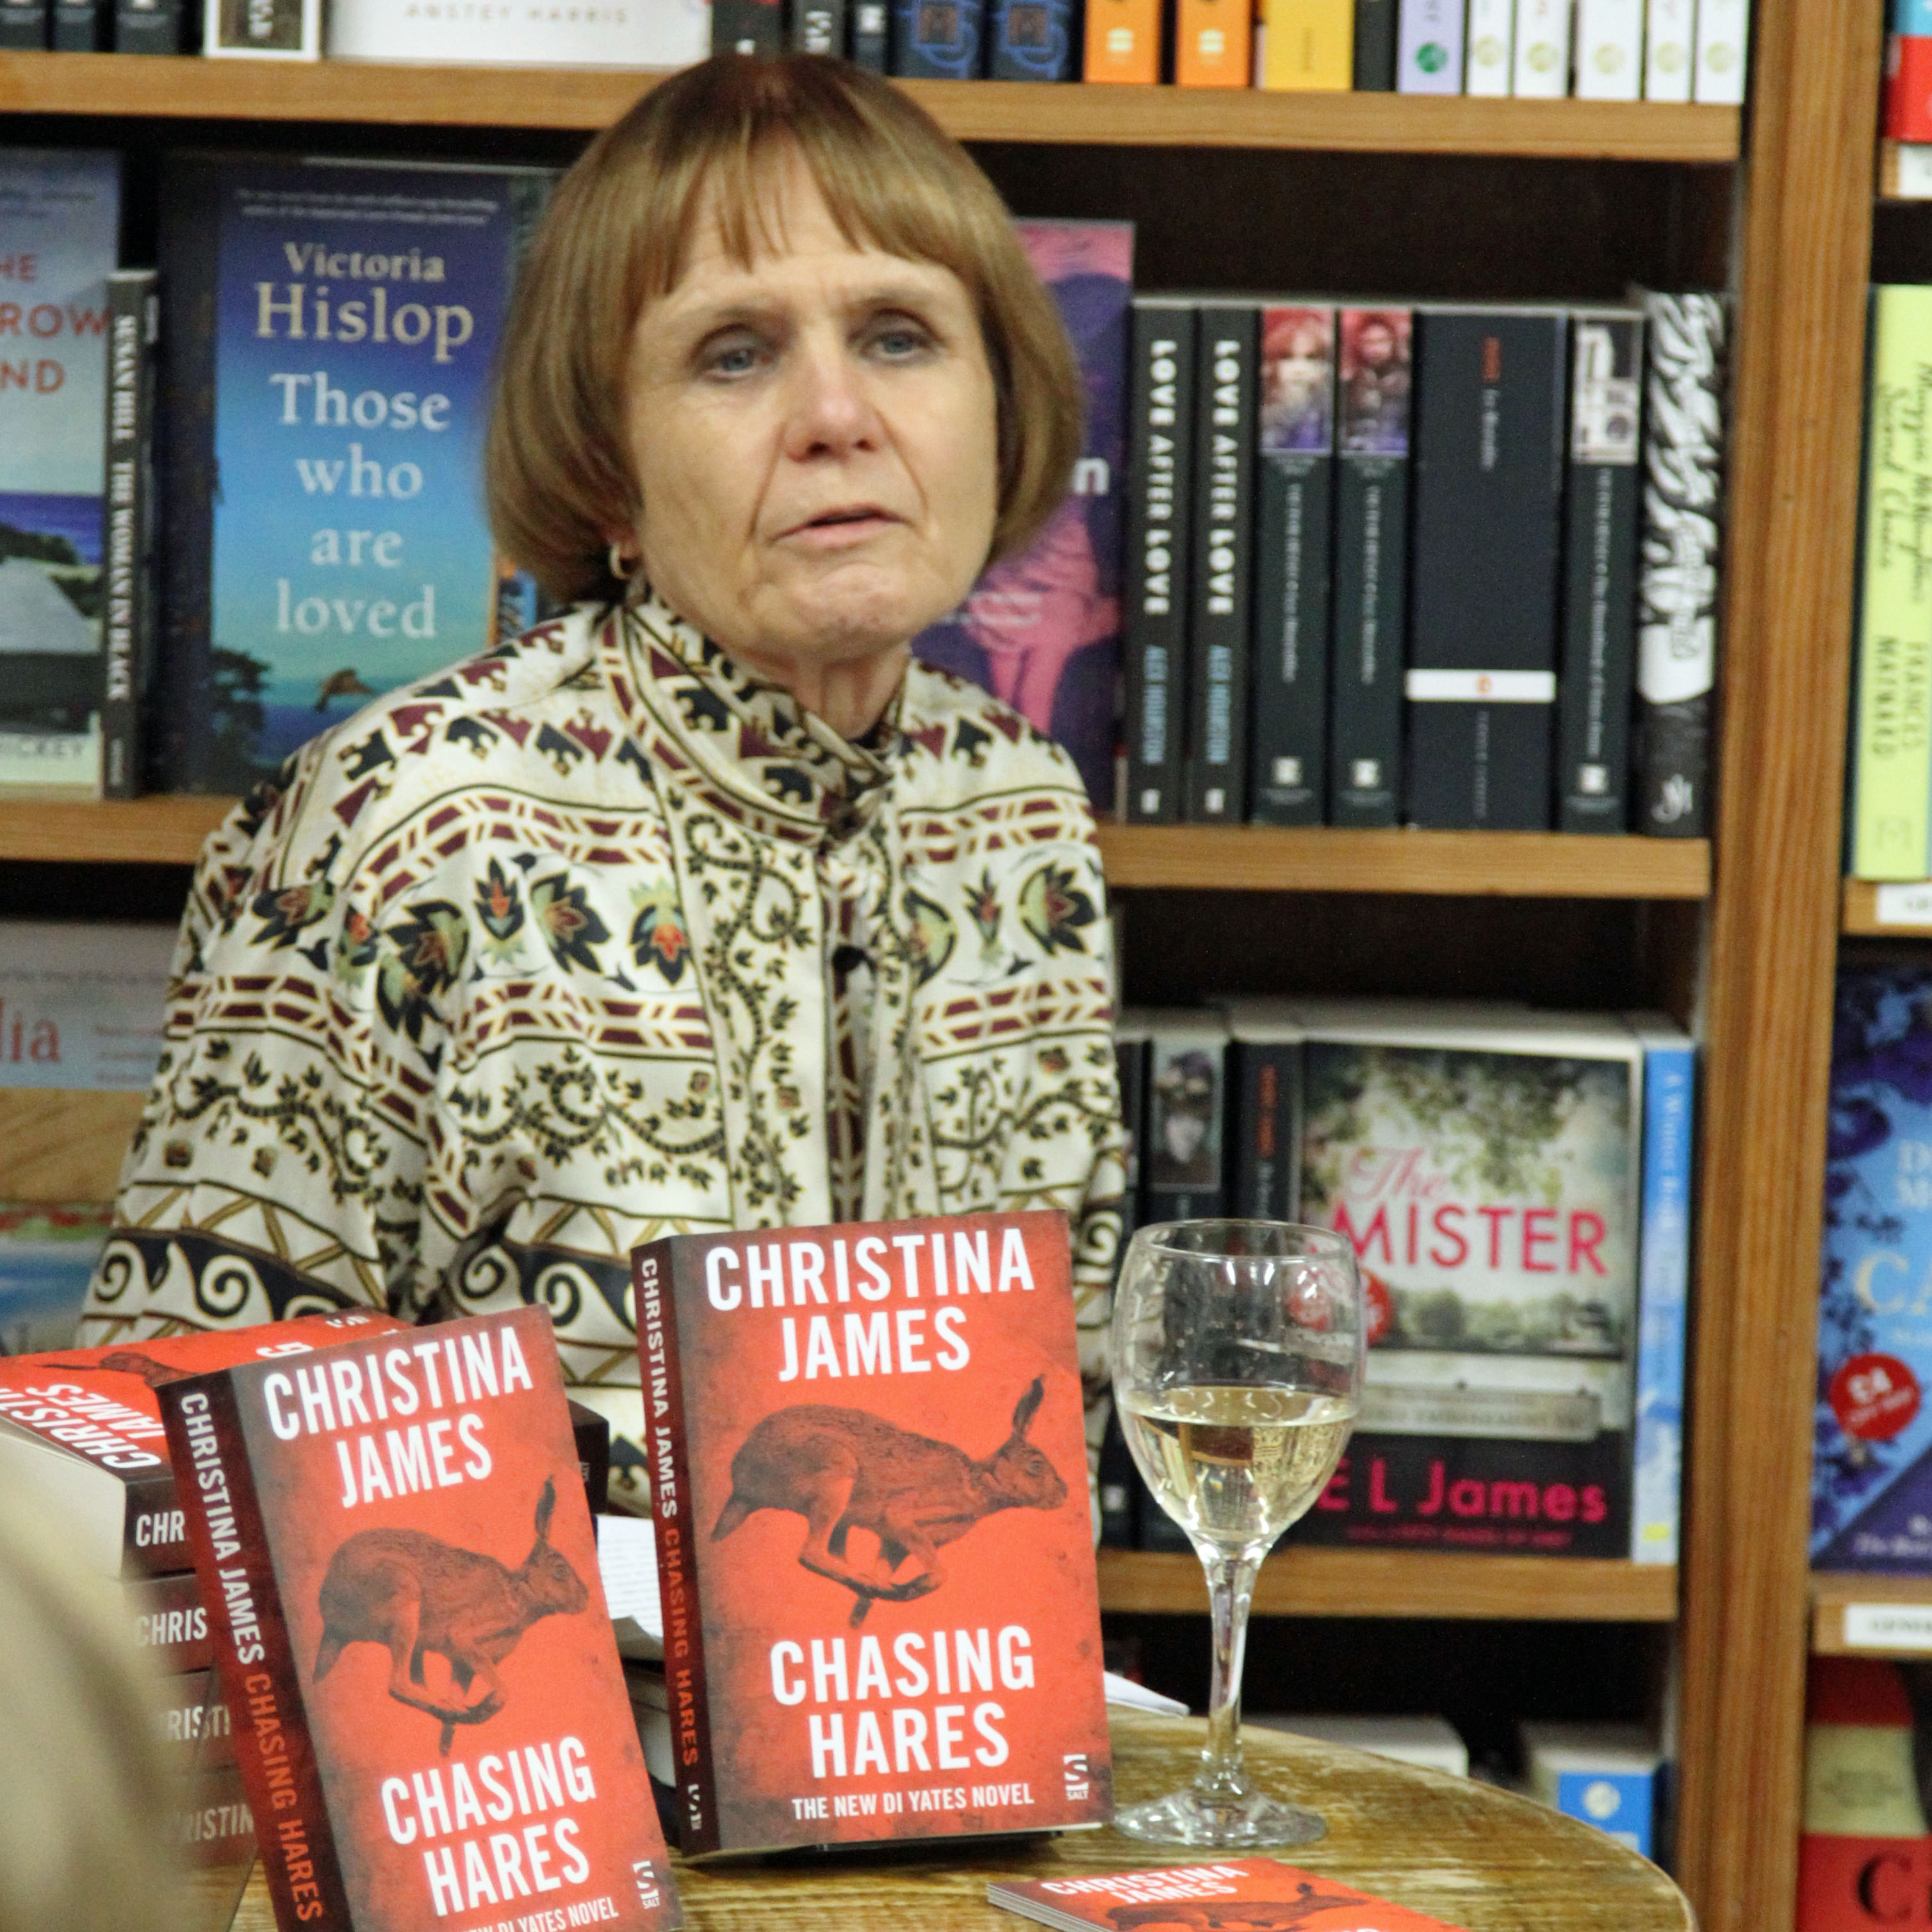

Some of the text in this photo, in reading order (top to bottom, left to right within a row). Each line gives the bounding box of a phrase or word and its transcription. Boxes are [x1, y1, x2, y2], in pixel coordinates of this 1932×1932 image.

[284, 242, 445, 282] Victoria
[256, 282, 474, 363] Hislop
[111, 315, 137, 440] SUSAN HILL
[269, 372, 451, 431] Those
[297, 443, 423, 500] who
[1143, 340, 1177, 616] LOVE AFTER LOVE
[1206, 340, 1241, 616] LOVE AFTER LOVE
[106, 461, 135, 700] THE WOMAN IN BLACK
[311, 528, 404, 567] are
[277, 578, 437, 638] loved
[1348, 1147, 1449, 1202] The
[705, 1227, 1035, 1311] CHRISTINA
[1332, 1202, 1611, 1277] MISTER
[263, 1325, 534, 1441] CHRISTINA
[778, 1306, 971, 1383] JAMES
[640, 1257, 678, 1519] CHRISTINA JAMES
[335, 1412, 494, 1509] JAMES
[1368, 1457, 1398, 1513] L
[1416, 1459, 1607, 1524] James
[181, 1393, 266, 1666] CHRISTINA JAMES
[664, 1528, 700, 1768] CHASING HARES
[769, 1625, 1036, 1706] CHASING
[808, 1701, 1010, 1780] HARES
[183, 1802, 254, 1843] ISTIN
[245, 1672, 323, 1922] CHASING HARES
[381, 1736, 597, 1846] CHASING
[792, 1782, 1035, 1821] THE NEW DI YATES NOVEL
[1066, 1789, 1088, 1801] SALT
[423, 1817, 591, 1918] HARES
[642, 1897, 661, 1910] SALT
[1040, 1865, 1250, 1896] CHRISTINA
[1109, 1880, 1239, 1905] JAMES
[517, 1908, 567, 1932] YATES
[567, 1897, 619, 1926] NOVEL
